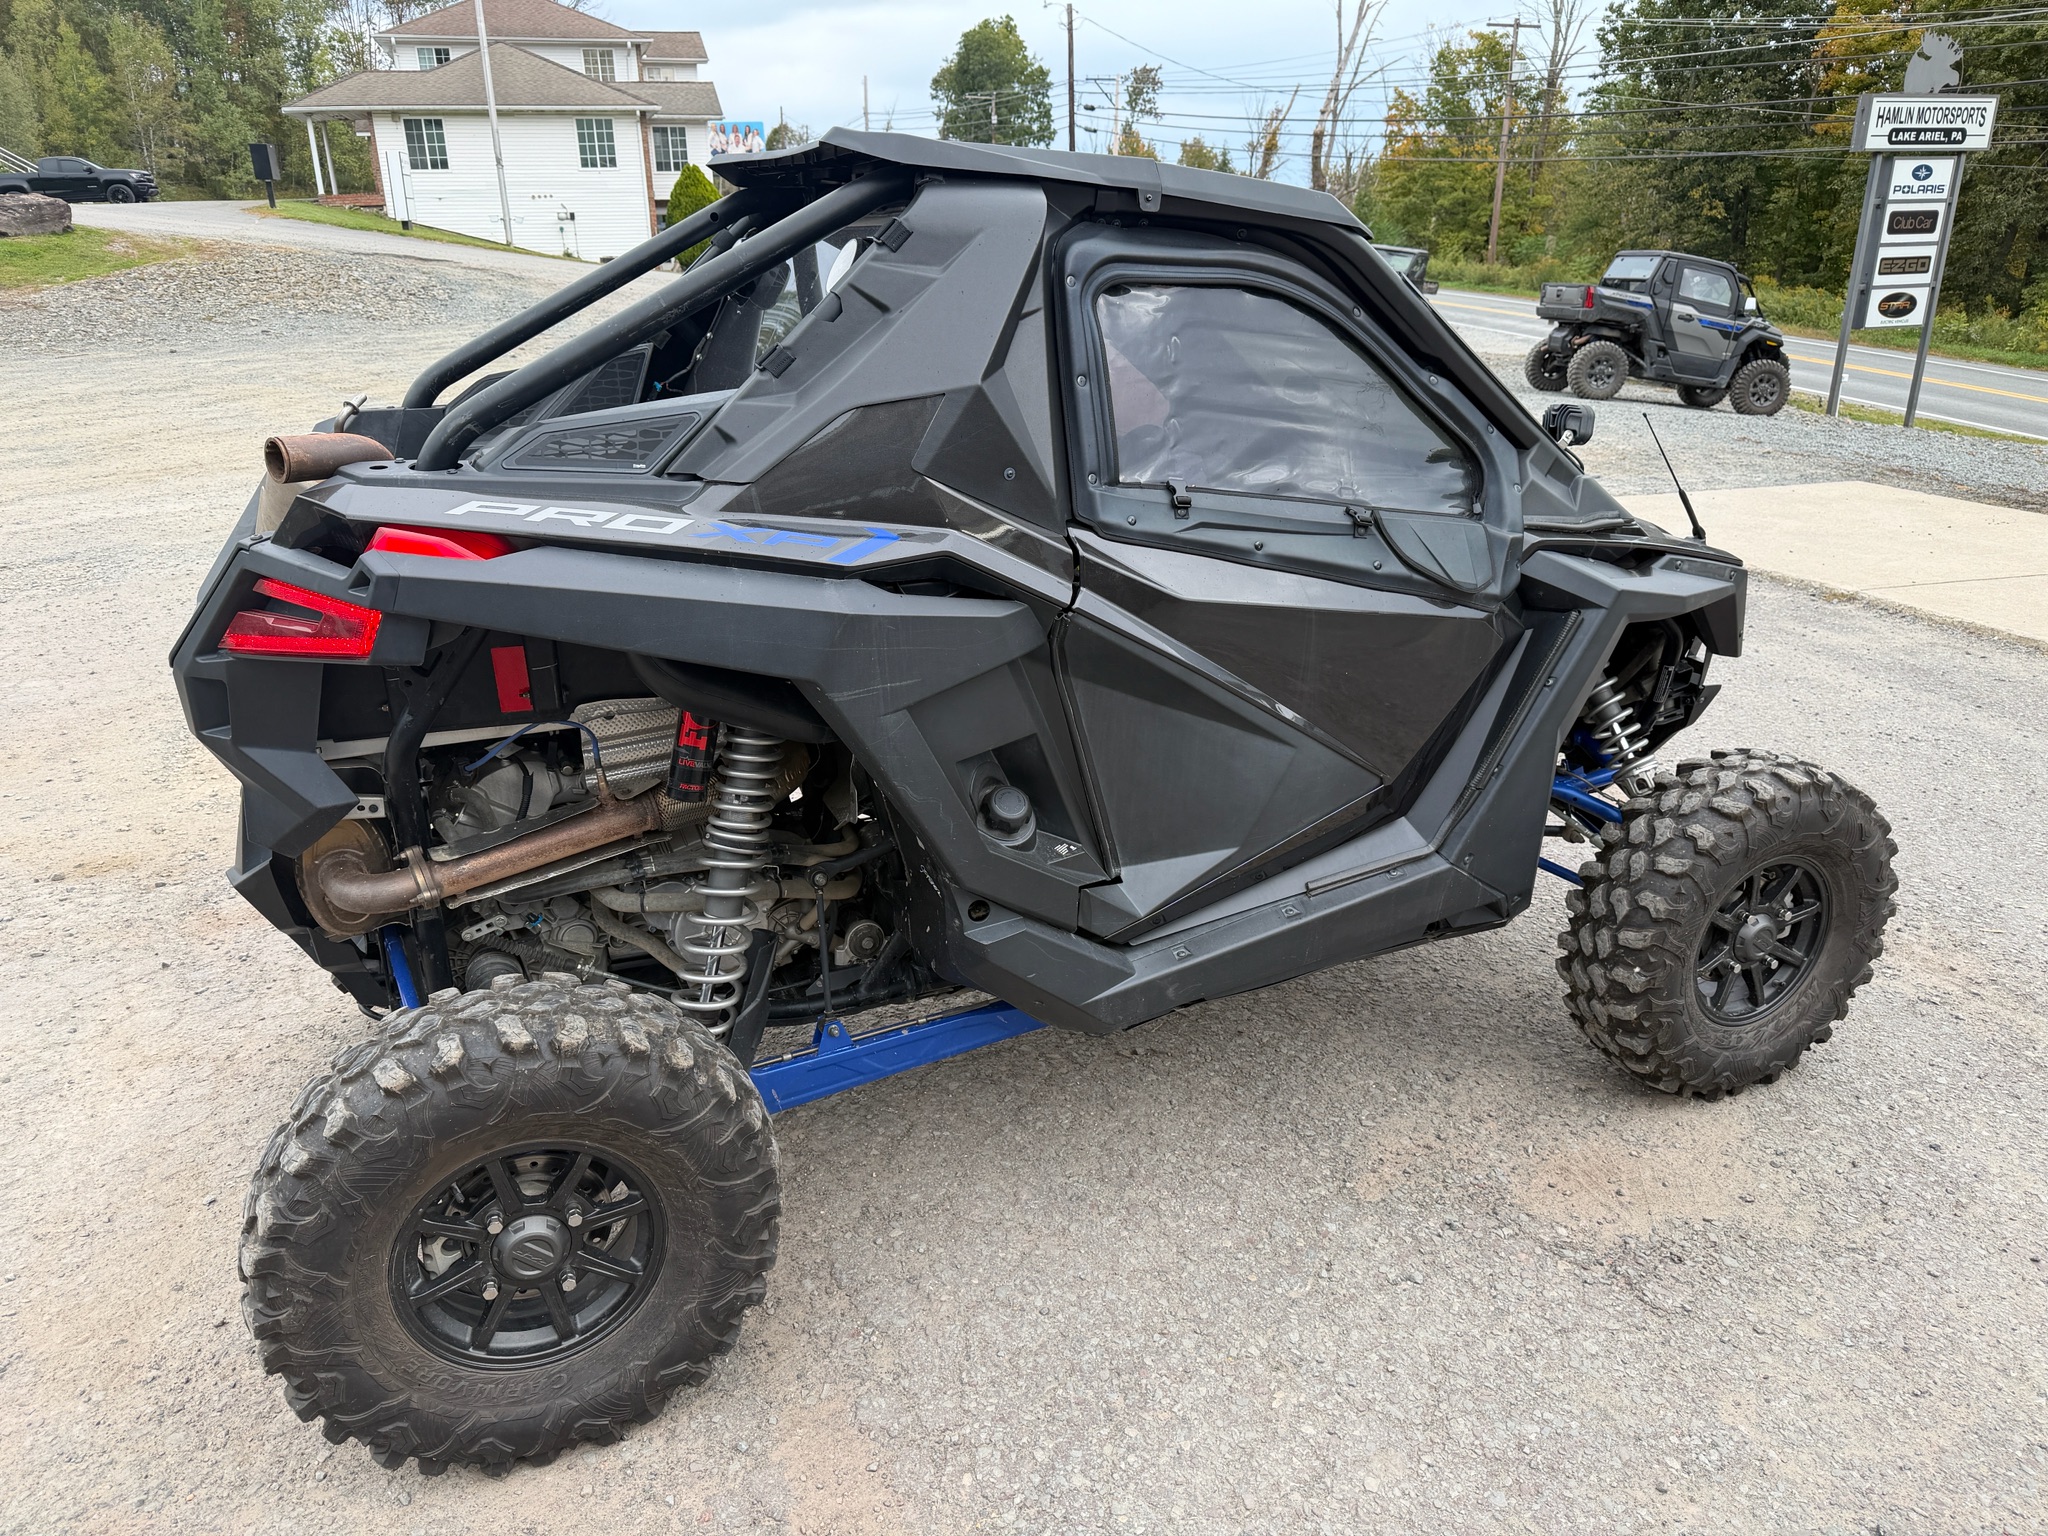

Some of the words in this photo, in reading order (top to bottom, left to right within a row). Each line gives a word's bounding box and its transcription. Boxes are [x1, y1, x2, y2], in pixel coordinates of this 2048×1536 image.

[1876, 106, 1915, 128] HAMLIN
[1916, 106, 1987, 128] MOTORSPORTS
[1892, 131, 1917, 141] LAKE
[1918, 131, 1948, 143] ARIEL,
[1951, 131, 1962, 141] PA
[1893, 184, 1945, 195] POLARIS
[1893, 216, 1915, 229] Club
[1915, 216, 1933, 229] Car
[444, 500, 695, 534] PRO
